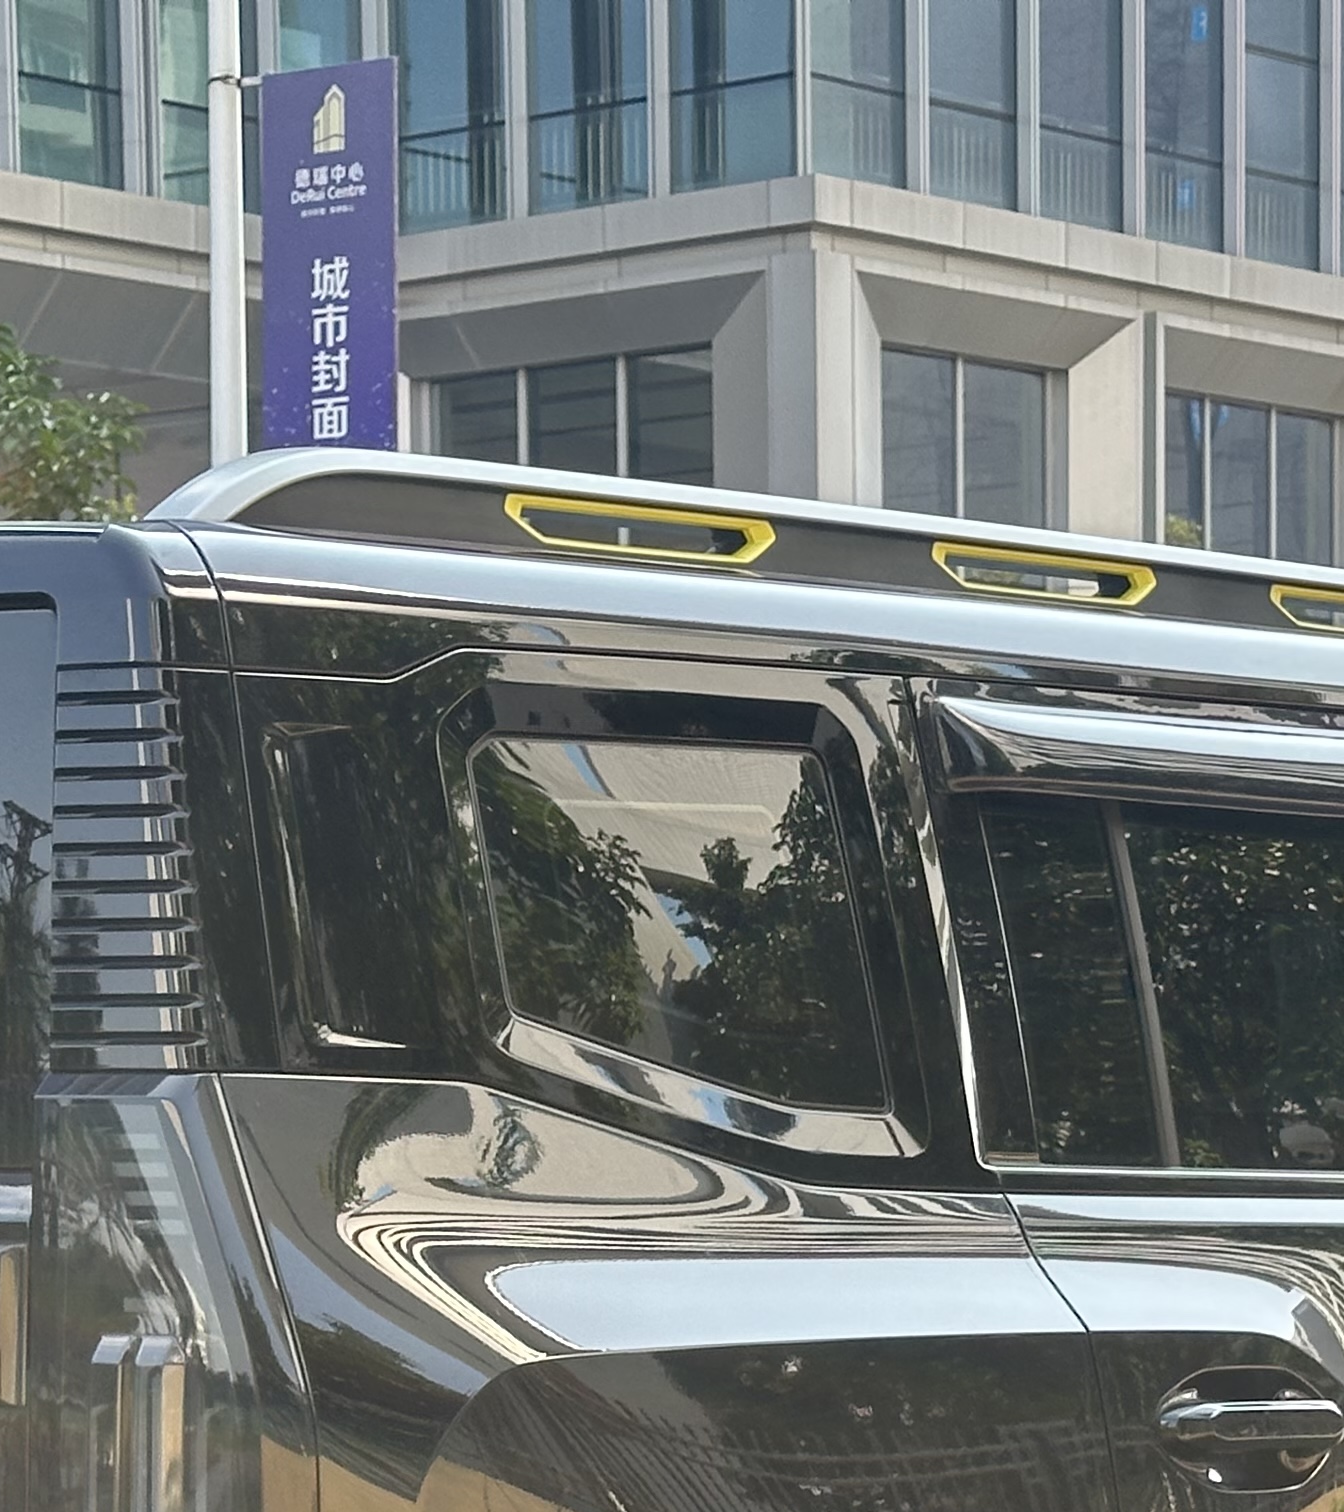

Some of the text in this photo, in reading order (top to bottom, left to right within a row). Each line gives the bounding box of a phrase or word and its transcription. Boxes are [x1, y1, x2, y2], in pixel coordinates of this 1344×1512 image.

[327, 185, 367, 200] Centre
[311, 256, 350, 441] 城市封面
